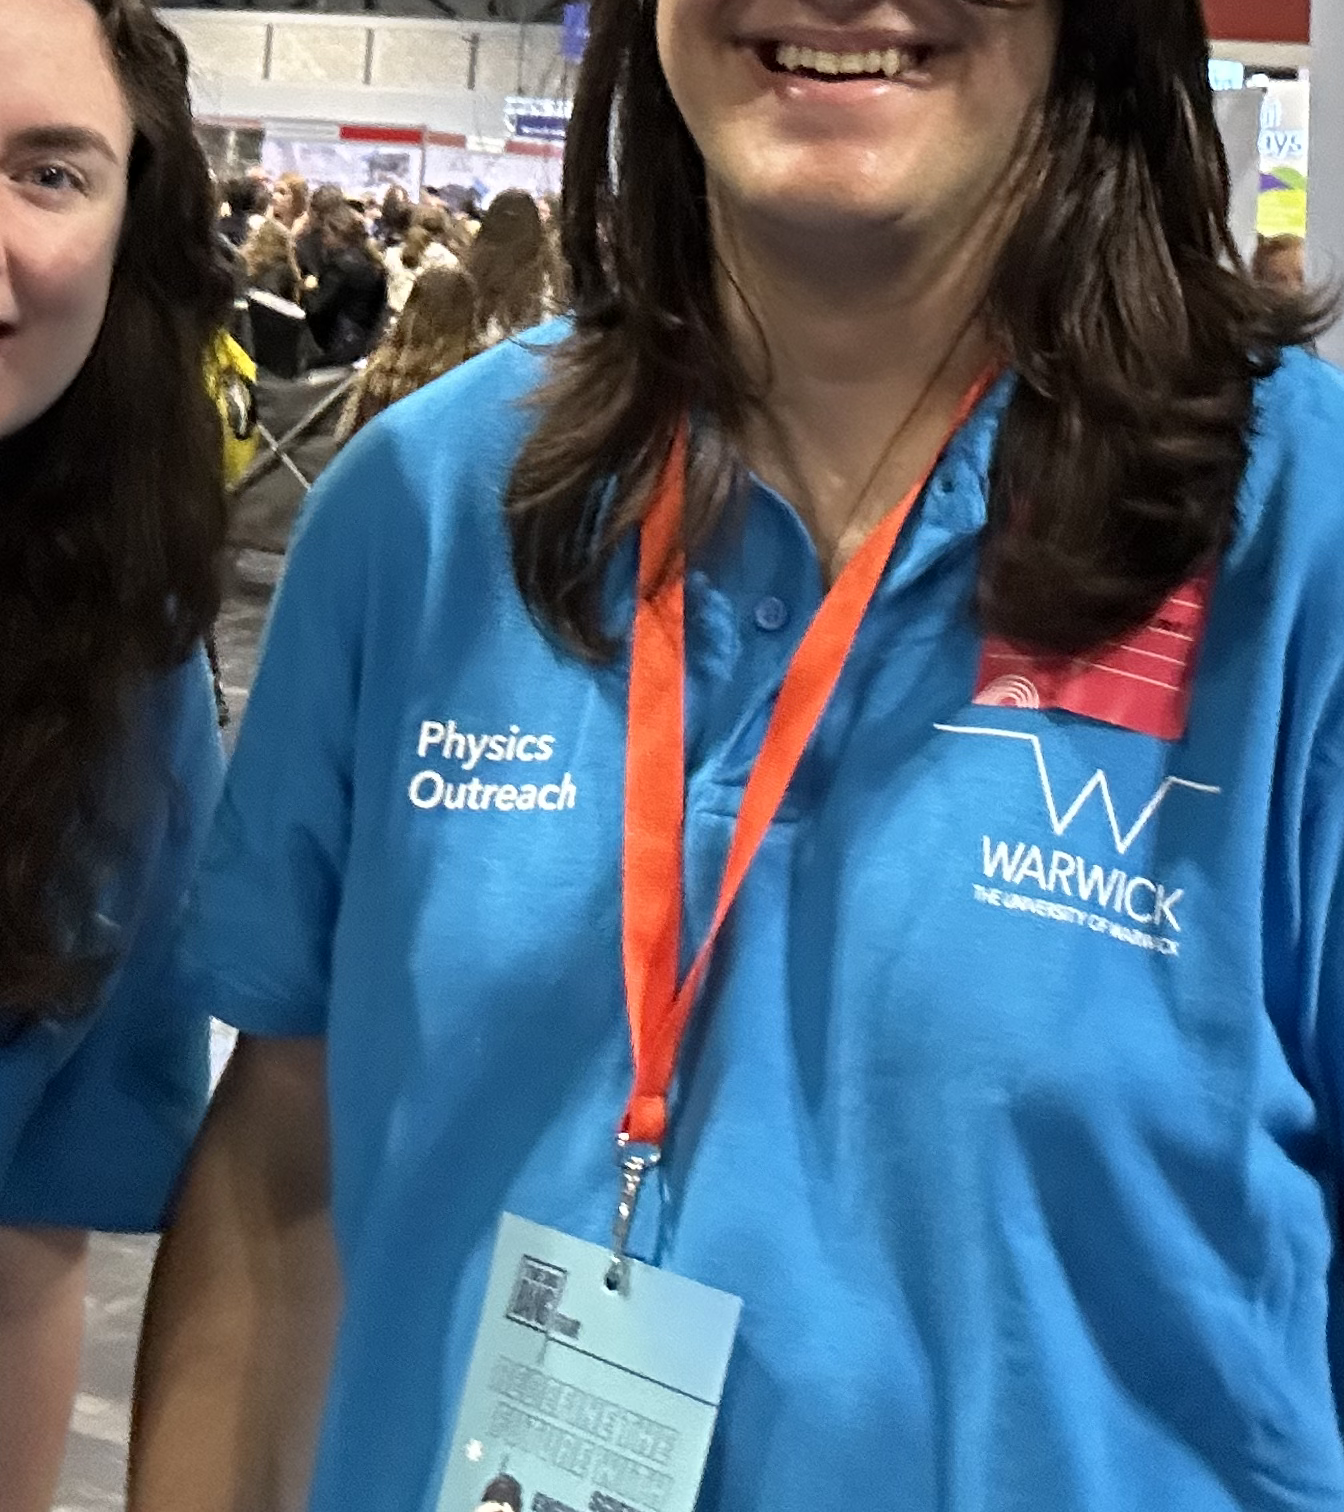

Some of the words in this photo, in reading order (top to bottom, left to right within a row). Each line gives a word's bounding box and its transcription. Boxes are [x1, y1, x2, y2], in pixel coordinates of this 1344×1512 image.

[417, 720, 555, 770] Physics
[408, 770, 576, 810] Outreach
[972, 884, 1003, 906] THE
[982, 835, 1184, 932] WARWICK
